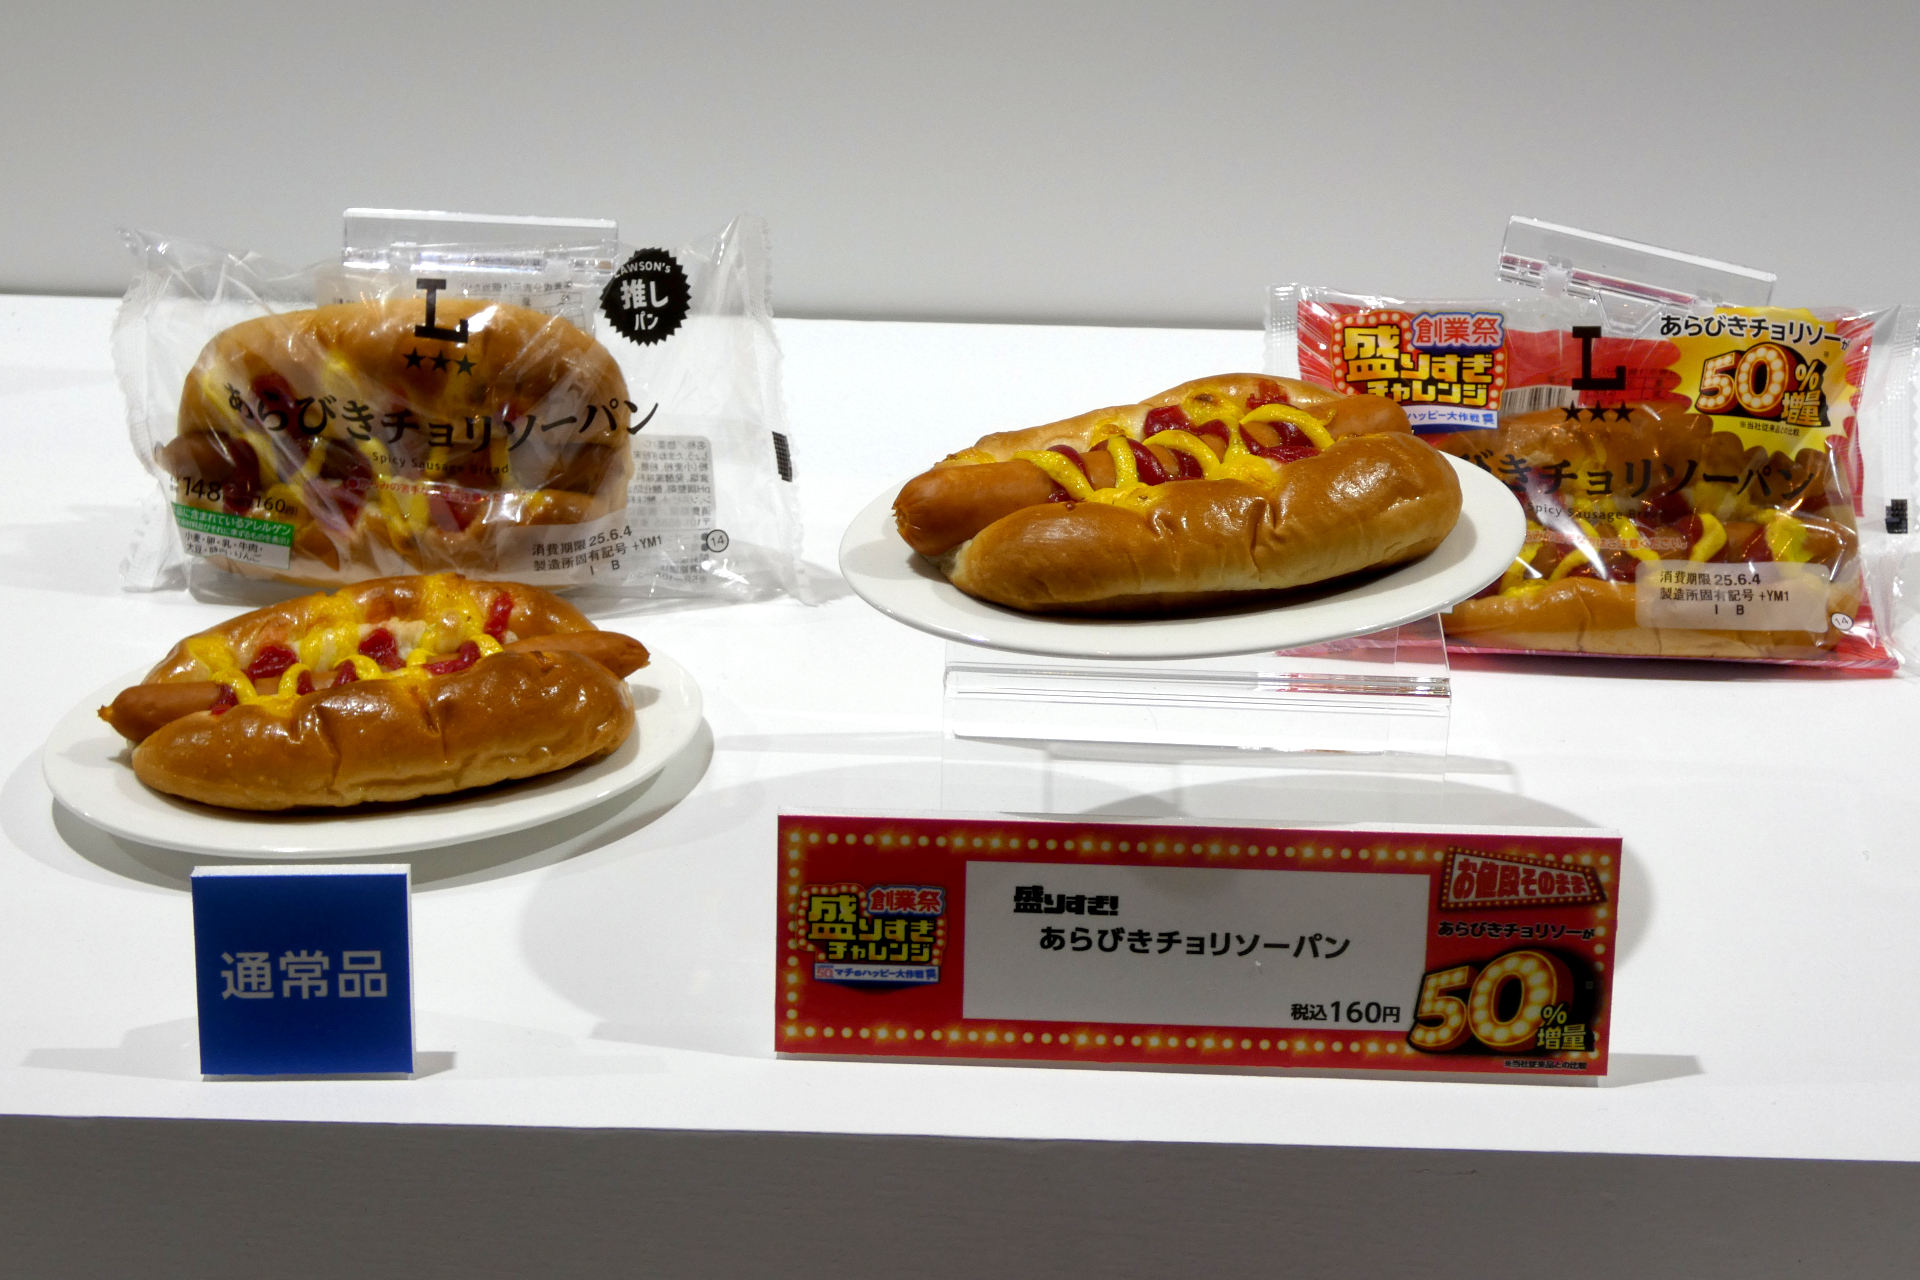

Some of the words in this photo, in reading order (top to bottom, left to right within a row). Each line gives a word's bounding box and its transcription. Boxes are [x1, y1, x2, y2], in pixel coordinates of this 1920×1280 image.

[615, 262, 671, 279] LAWSON's
[620, 279, 669, 310] 推し
[415, 278, 468, 343] L
[634, 312, 659, 331] パン
[1415, 317, 1499, 344] 創業祭
[1660, 315, 1850, 350] あらびきチョリソーが
[1343, 325, 1493, 384] 盛りすぎ
[1572, 326, 1626, 390] L
[1367, 380, 1487, 406] チャレンジ
[224, 382, 660, 451] あらびきチョリソーパン
[1781, 390, 1822, 426] 増量
[372, 452, 406, 468] Spicy
[412, 458, 464, 476] Sausage
[471, 463, 509, 474] Bread
[183, 476, 221, 501] 148
[1527, 501, 1562, 517] Spicy
[1567, 508, 1623, 523] Sausage
[532, 539, 586, 556] 消費期限
[589, 526, 632, 546] 25.6.4
[533, 544, 627, 571] 製造所固有記号
[633, 535, 662, 551] +YM1
[710, 535, 725, 547] 14
[611, 560, 620, 571] B
[1660, 570, 1711, 586] 消費期限
[1714, 573, 1761, 587] 25.6.4
[1659, 587, 1754, 602] 製造所固有記号
[1758, 589, 1789, 603] +YM1
[1736, 604, 1745, 616] B
[1453, 858, 1587, 900] お値段そのまま
[870, 889, 942, 912] 創業祭
[1013, 885, 1119, 916] 盛りすぎ!
[808, 895, 934, 942] 盛りすぎ
[1437, 921, 1595, 940] あらびきチョリソーが
[828, 941, 930, 962] チャレンジ
[1039, 926, 1351, 960] あらびきチョリソーパン
[220, 949, 388, 1000] 通常品
[1291, 1000, 1401, 1024] 税込160円
[1537, 1023, 1586, 1051] 増量
